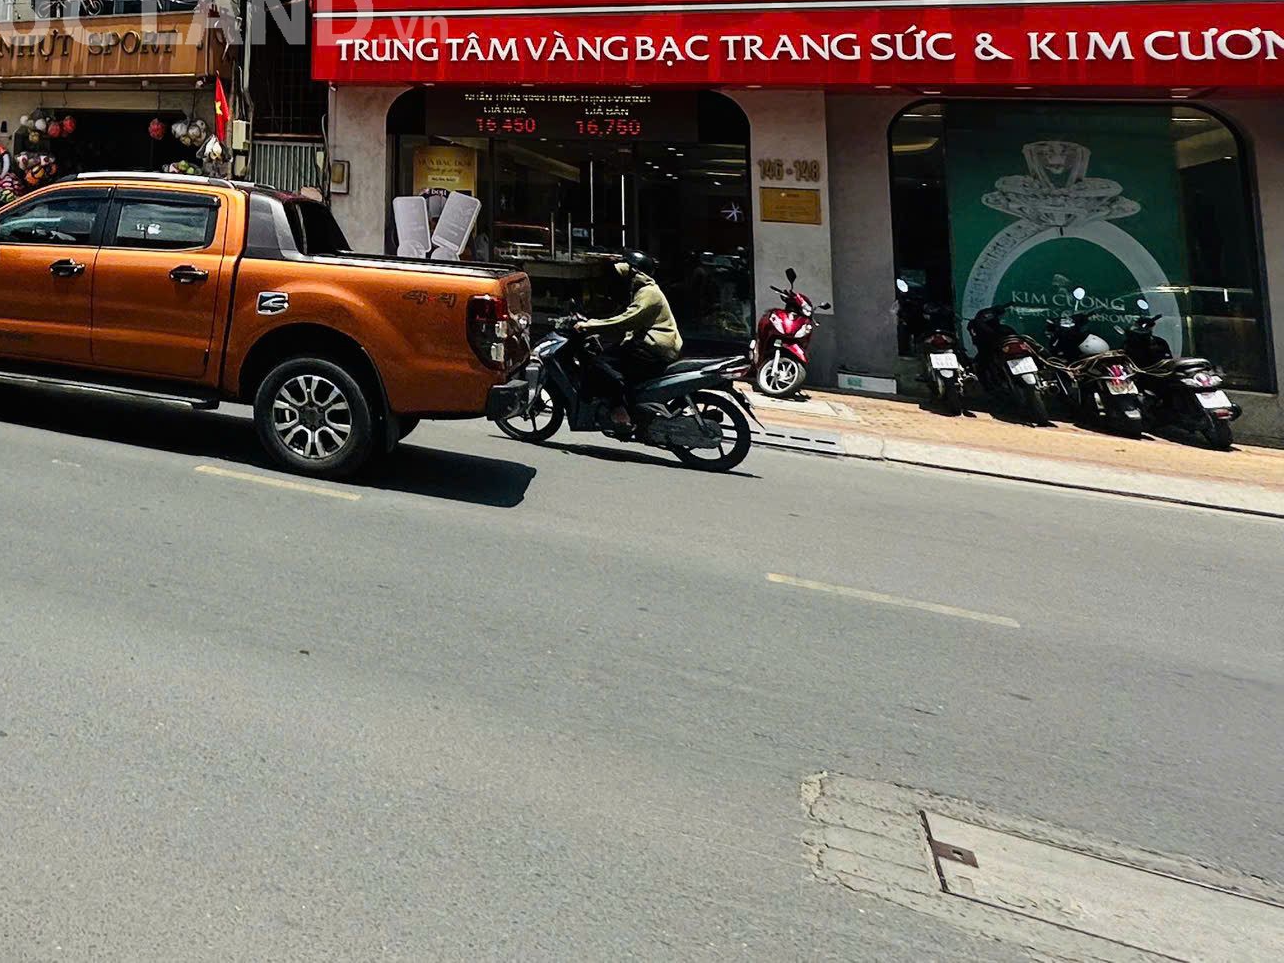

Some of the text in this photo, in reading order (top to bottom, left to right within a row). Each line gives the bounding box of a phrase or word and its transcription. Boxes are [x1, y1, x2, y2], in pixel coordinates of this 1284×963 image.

[87, 28, 179, 56] SPORT
[335, 37, 439, 62] TRUNG
[445, 32, 519, 62] TÂM
[523, 30, 630, 62] VÀNG
[635, 34, 710, 68] BẠC
[719, 33, 861, 61] TRANG
[870, 24, 956, 61] SỨC
[974, 32, 1015, 61] &
[1026, 31, 1136, 61] KIM
[1011, 290, 1048, 305] KIM
